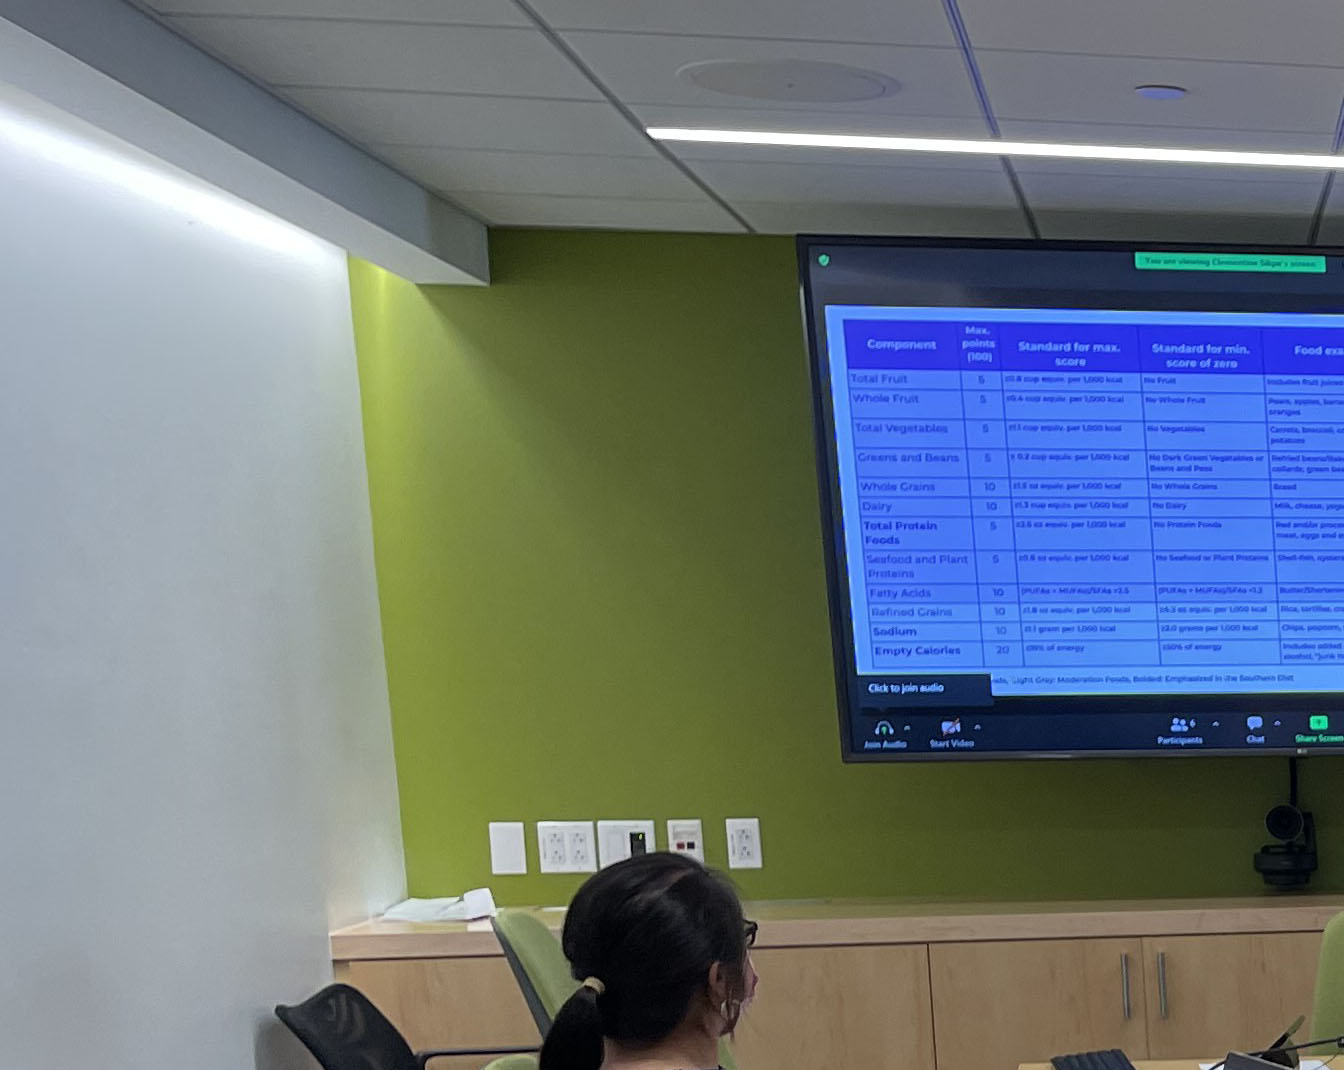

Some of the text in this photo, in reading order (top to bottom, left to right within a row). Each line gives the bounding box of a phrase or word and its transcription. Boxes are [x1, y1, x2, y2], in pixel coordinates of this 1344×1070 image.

[868, 339, 936, 350] Component
[962, 339, 995, 349] points
[1019, 342, 1120, 352] Standard for max.
[1152, 344, 1203, 353] Standard
[1206, 344, 1222, 353] for
[1294, 346, 1322, 356] Food
[1056, 358, 1086, 366] score
[1167, 360, 1196, 368] score
[1200, 359, 1210, 368] of
[851, 374, 908, 384] Total Fruit
[852, 394, 919, 403] Whole Fruit
[856, 424, 948, 434] Total Vegetables
[858, 452, 959, 462] Greens and Beans
[860, 482, 935, 492] Whole Grains
[862, 502, 892, 512] Dairy
[864, 521, 937, 530] Total Protein
[866, 536, 900, 545] Foods
[867, 555, 968, 564] Seafood and Plant
[868, 569, 914, 579] Proteins
[870, 589, 931, 599] Fatty Acids
[872, 608, 952, 617] Refined Grains
[874, 627, 916, 636] Sodium
[875, 646, 960, 657] Empty Calories
[868, 683, 944, 695] Click to join audio
[930, 739, 974, 748] Start Video
[1158, 735, 1202, 744] Participants
[1247, 734, 1265, 744] Chat
[1296, 734, 1344, 743] Share Screen
[864, 740, 906, 749] Join Audio
